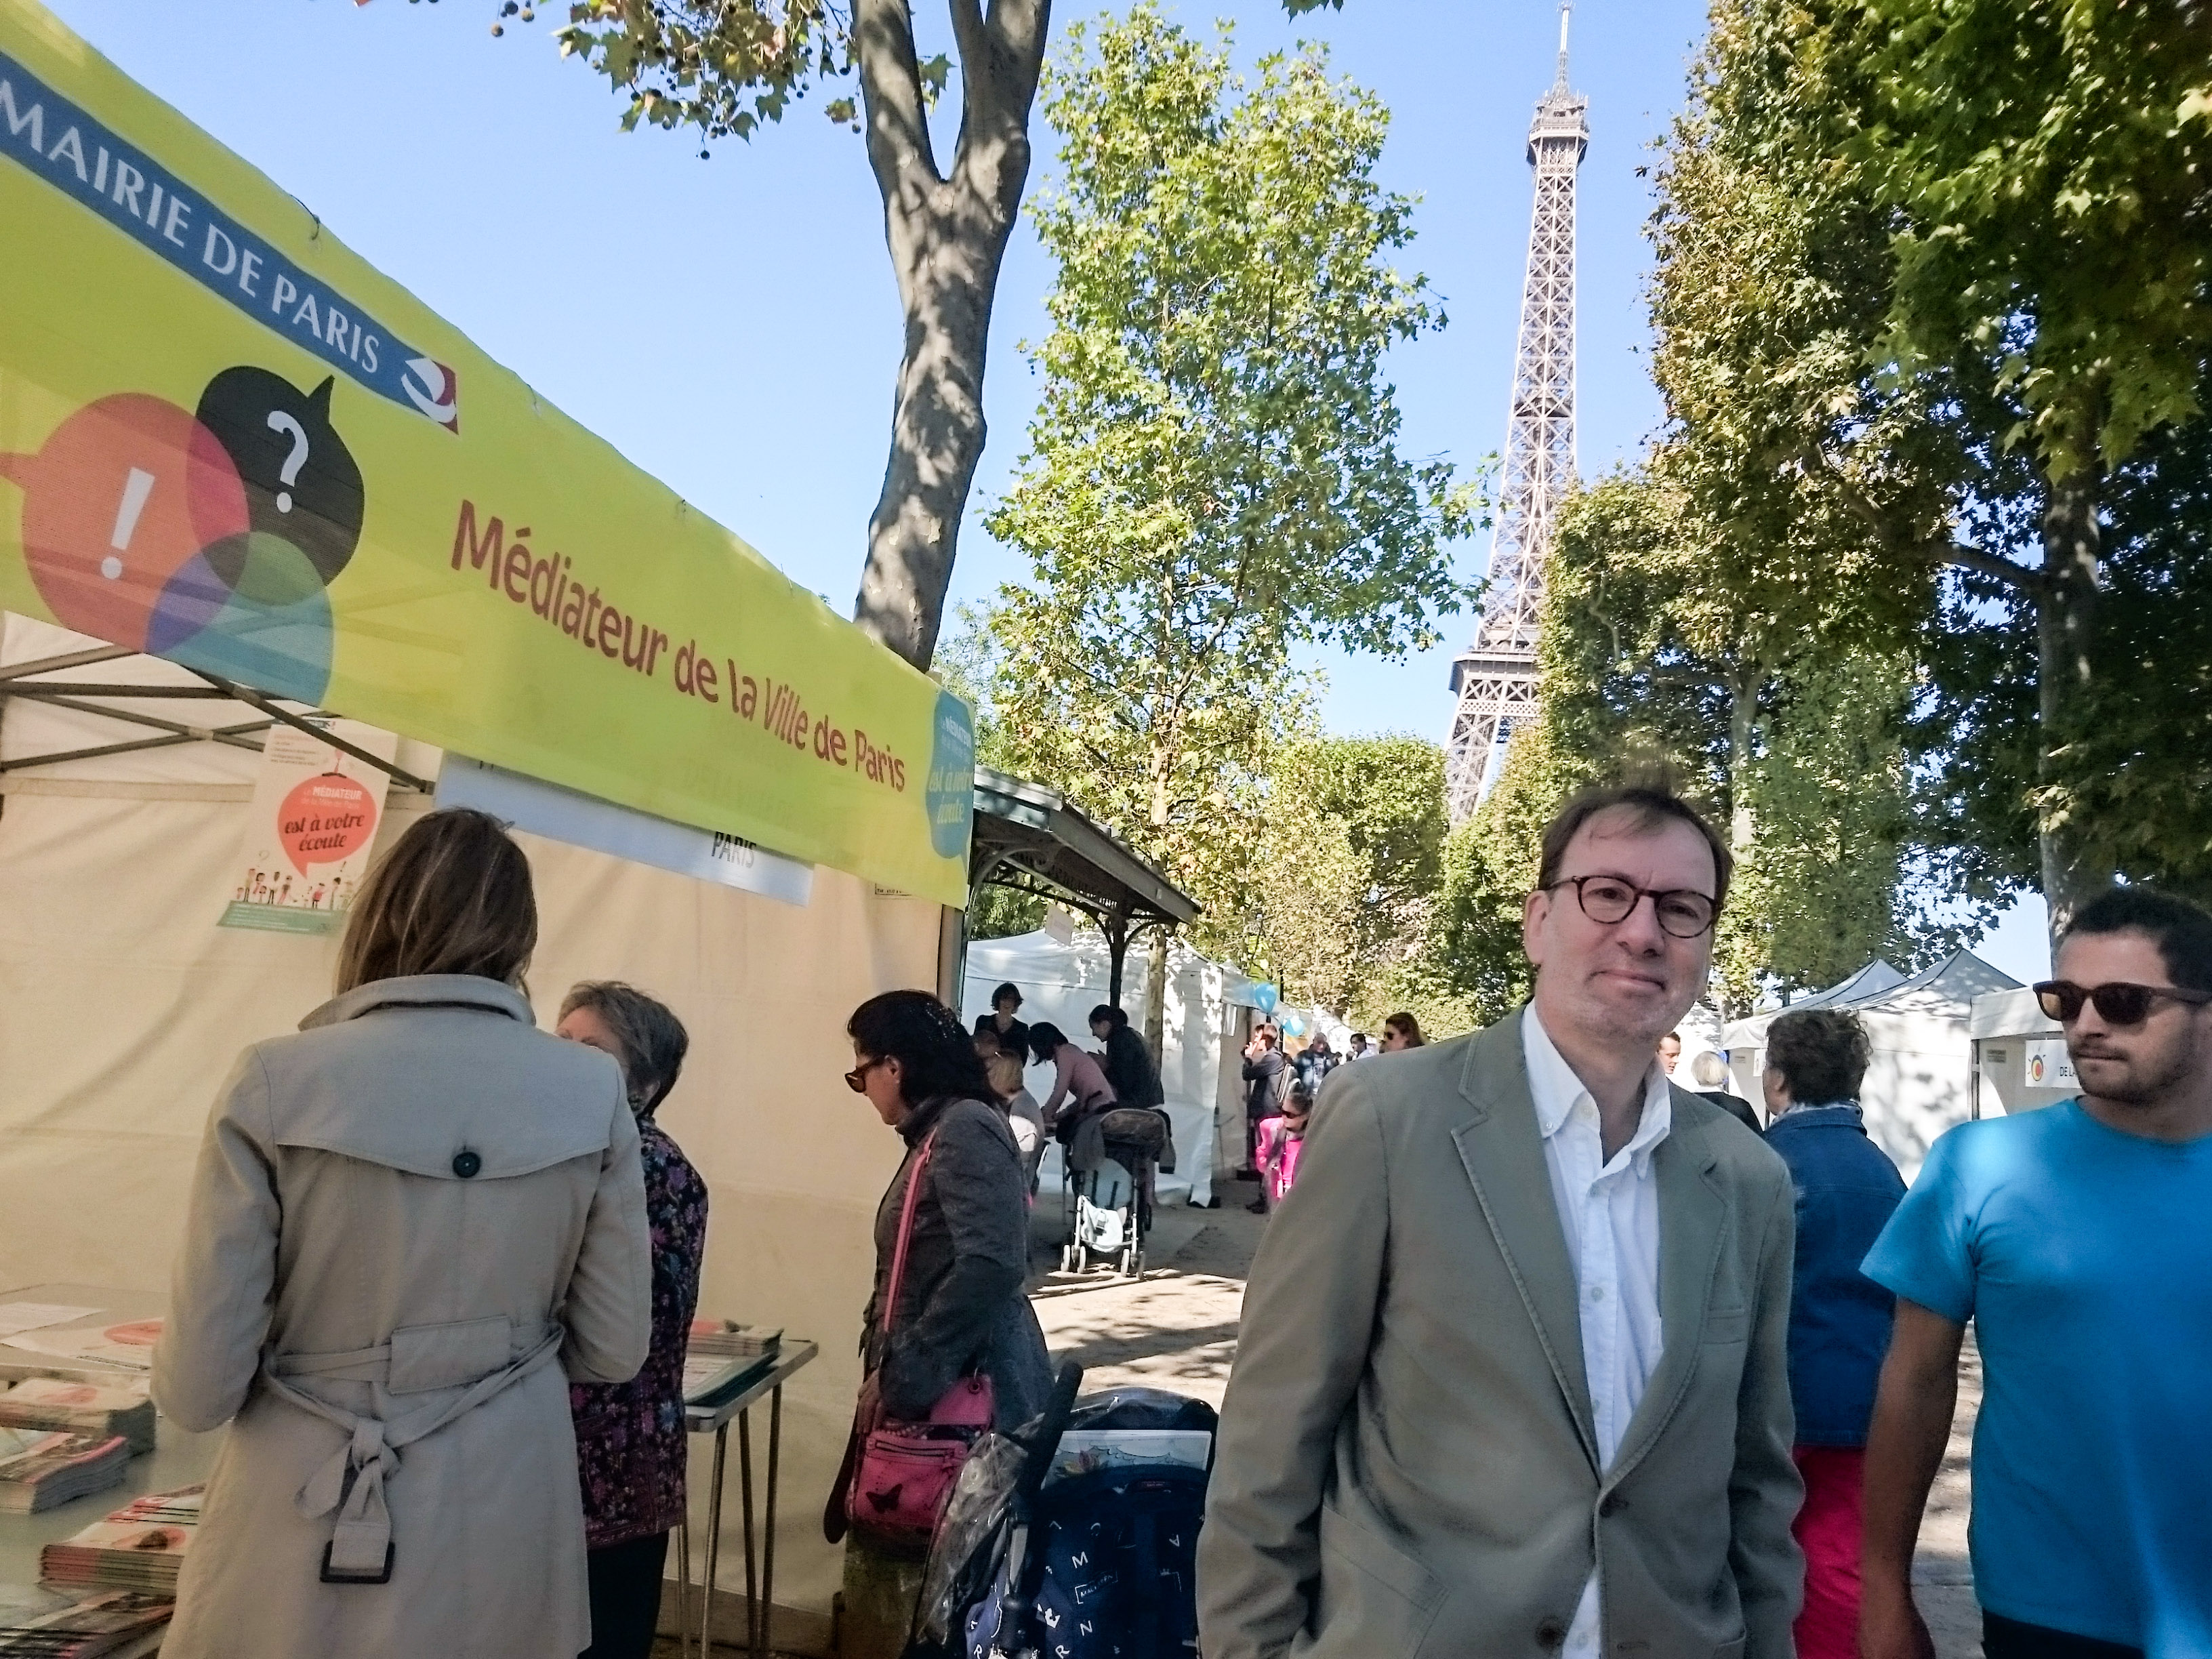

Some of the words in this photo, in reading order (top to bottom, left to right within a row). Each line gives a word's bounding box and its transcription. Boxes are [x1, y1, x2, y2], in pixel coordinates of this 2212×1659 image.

[0, 79, 191, 249] MAIRIE
[203, 222, 263, 298] DE
[272, 273, 380, 373] PARIS
[451, 499, 668, 676] Médiateur
[674, 638, 719, 703] de
[727, 658, 757, 722] la
[764, 678, 808, 750] Ville
[814, 714, 847, 766] de
[855, 729, 905, 792] Paris
[312, 785, 363, 800] MÉDIATEUR
[285, 817, 306, 834] est
[310, 813, 321, 832] à
[325, 813, 365, 830] votre
[299, 833, 348, 851] écoute
[711, 831, 757, 868] PARIS
[2060, 1067, 2068, 1076] DE
[2069, 1067, 2074, 1077] L
